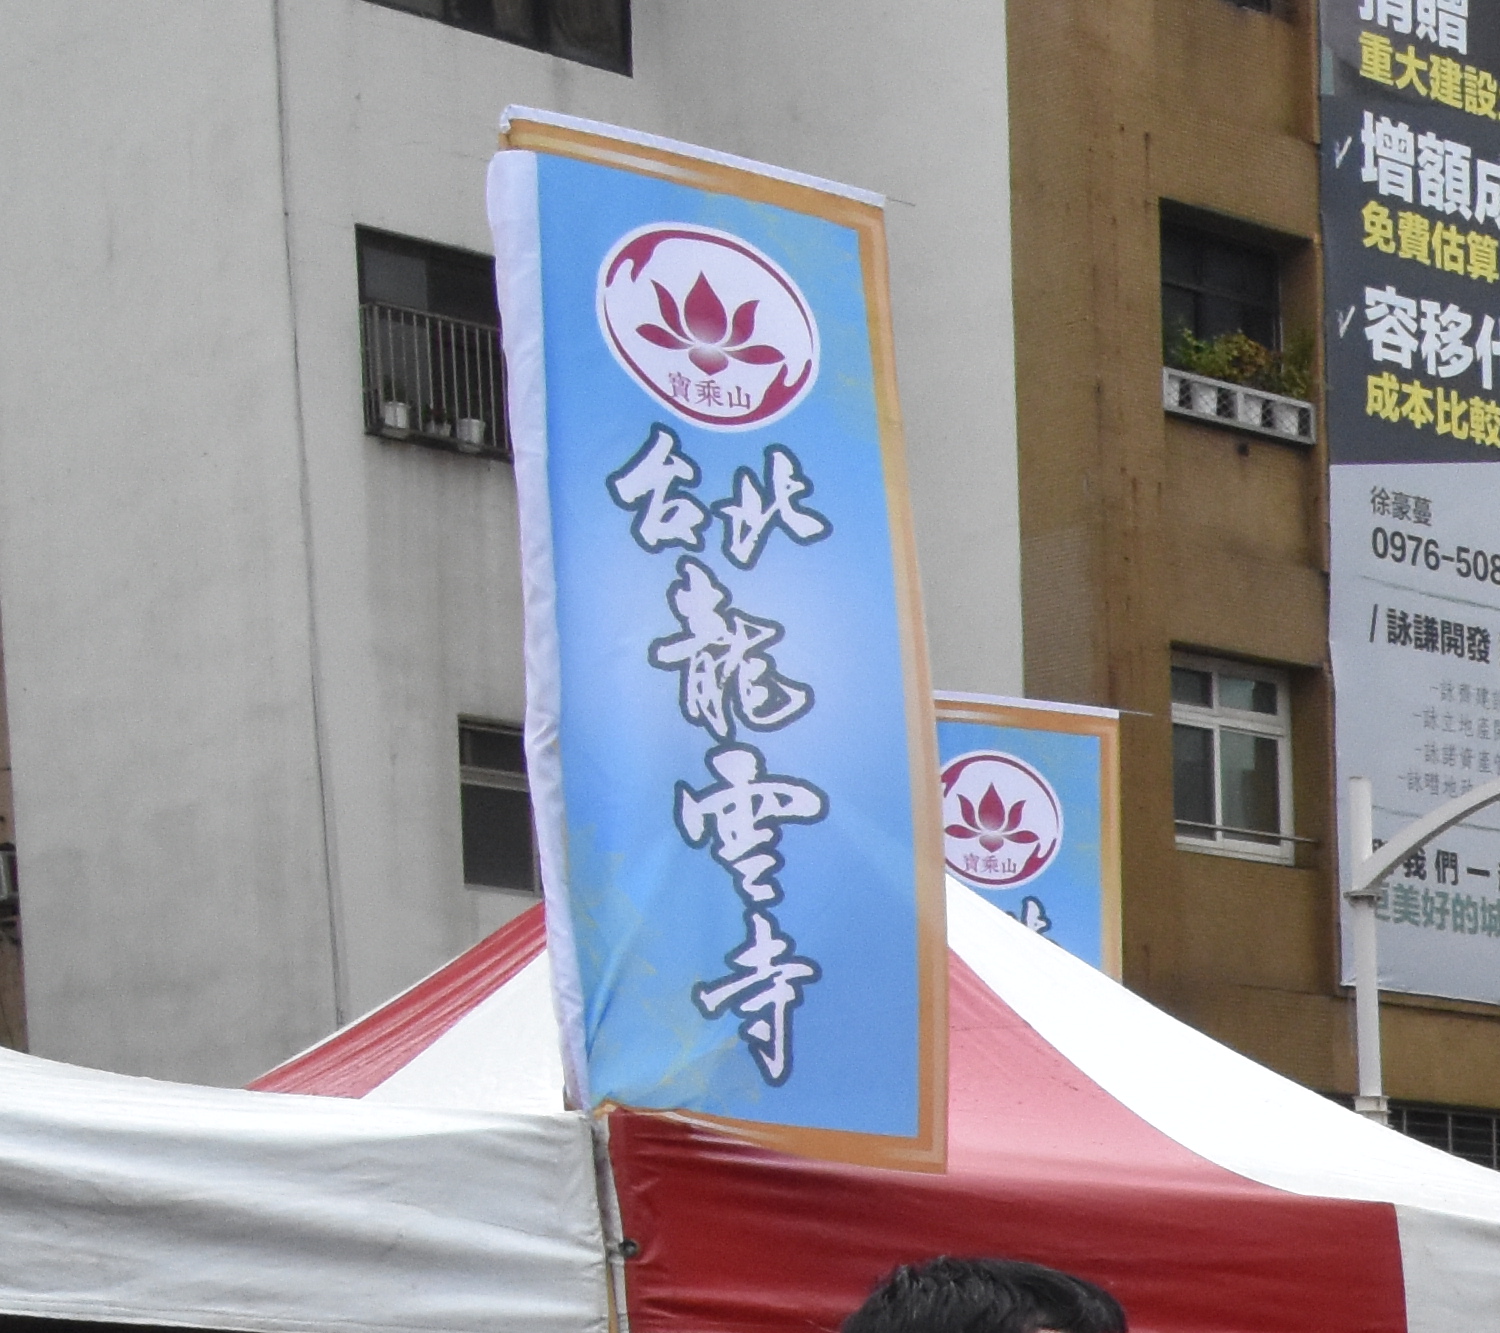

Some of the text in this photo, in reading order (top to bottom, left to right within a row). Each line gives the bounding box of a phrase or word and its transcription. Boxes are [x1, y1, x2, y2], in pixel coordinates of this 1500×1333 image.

[1361, 200, 1500, 284] 免費估算
[667, 370, 753, 414] 寶乘山
